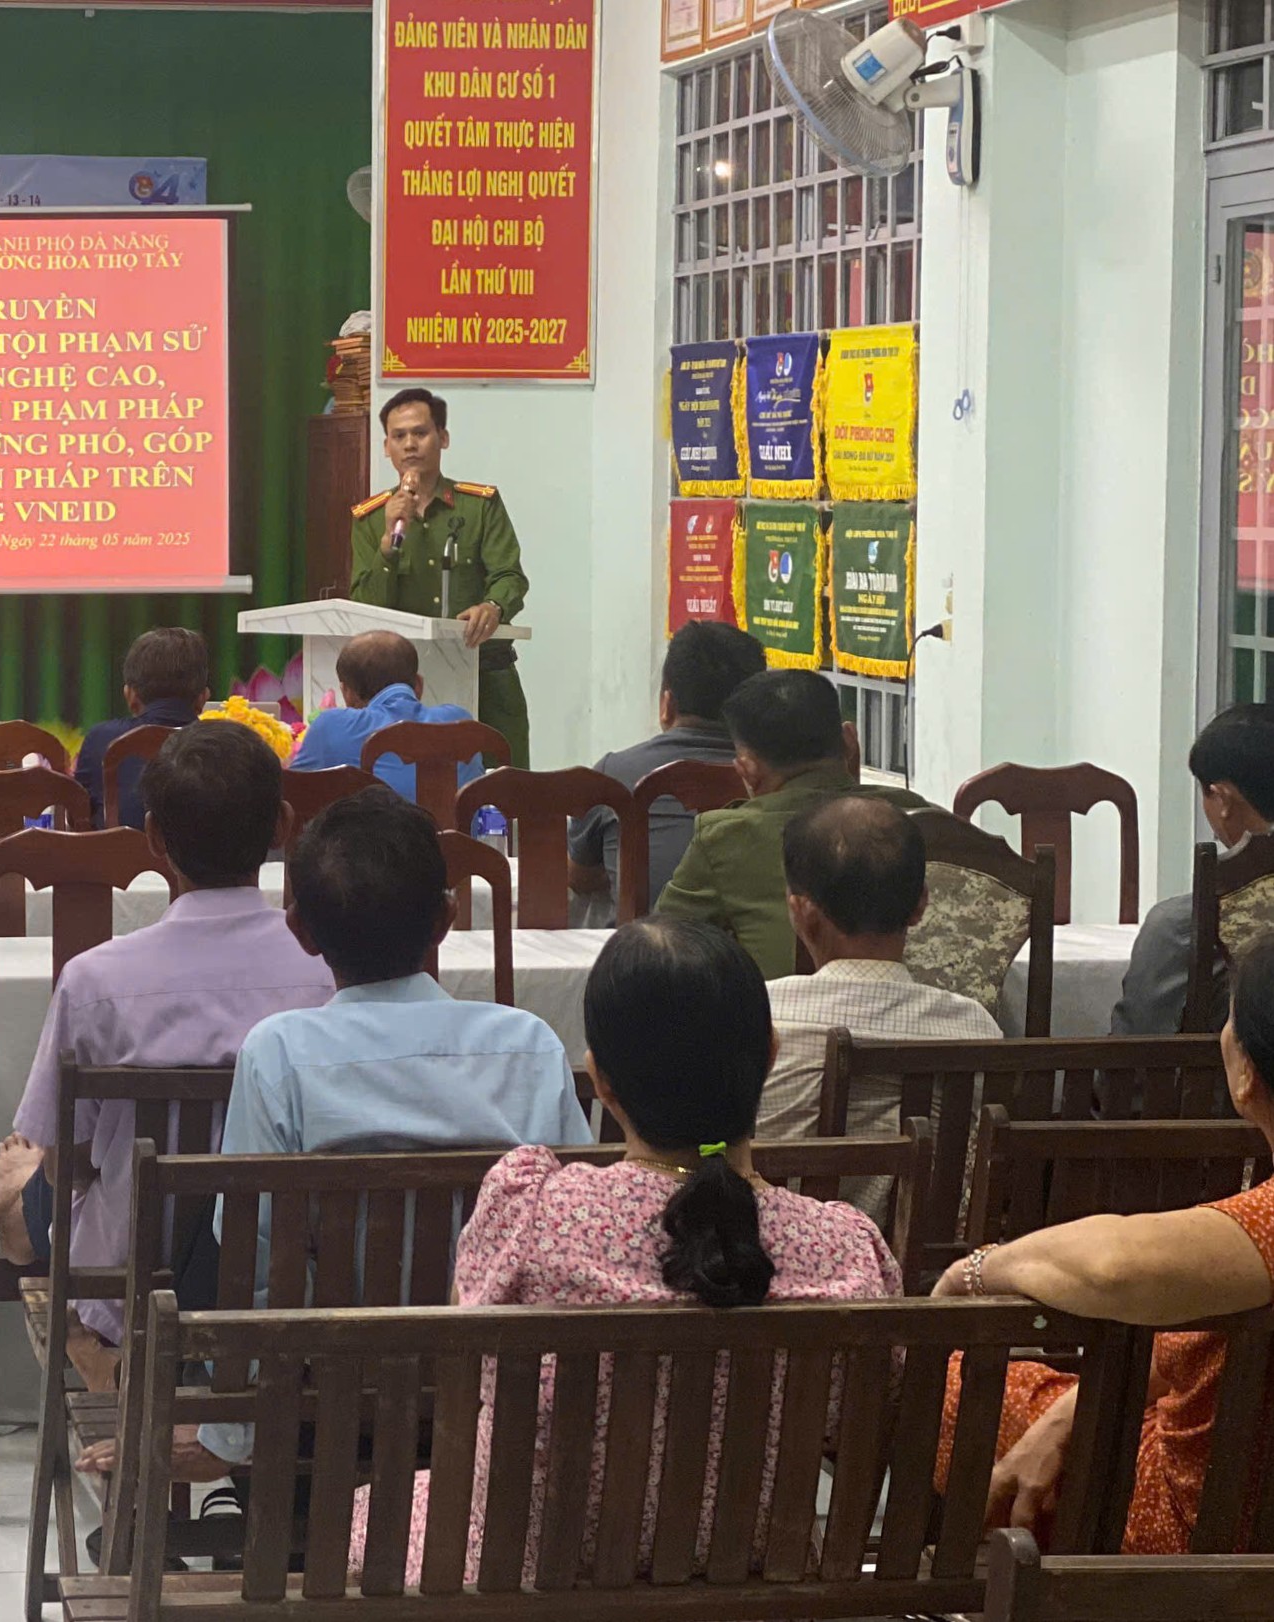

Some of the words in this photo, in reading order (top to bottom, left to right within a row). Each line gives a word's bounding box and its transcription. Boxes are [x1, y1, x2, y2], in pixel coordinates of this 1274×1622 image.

[394, 13, 437, 48] ĐẢNG
[442, 17, 478, 49] VIÊN
[483, 17, 502, 49] VÀ
[507, 18, 550, 49] NHÂN
[555, 18, 587, 50] DÂN
[424, 71, 456, 97] KHU
[460, 67, 492, 98] DÂN
[497, 70, 519, 98] CƯ
[523, 64, 544, 99] SỐ
[548, 74, 555, 98] 1
[404, 113, 453, 149] QUYẾT
[457, 116, 490, 148] TÂM
[495, 119, 534, 154] THỰC
[539, 117, 575, 154] HIỆN
[402, 160, 453, 196] THẮNG
[458, 168, 481, 202] LỢI
[486, 171, 524, 202] NGHỊ
[528, 163, 576, 199] QUYẾT
[8, 194, 19, 206] 13
[29, 195, 41, 206] 14
[36, 233, 75, 251] PHỐ
[80, 232, 107, 250] ĐÀ
[432, 219, 457, 251] ĐẠI
[463, 214, 488, 251] HỘI
[493, 220, 519, 246] CHI
[524, 215, 545, 251] BỘ
[47, 252, 91, 270] HÒA
[95, 253, 138, 272] THỌ
[144, 248, 183, 268] TÂY
[441, 259, 471, 294] LẦN
[476, 263, 507, 294] THỨ
[510, 269, 534, 295] VIII
[59, 332, 154, 358] PHẠM
[163, 324, 207, 352] SỬ
[407, 312, 457, 349] NHIỆM
[462, 312, 482, 344] KỲ
[486, 319, 568, 344] 2025-2027
[87, 364, 166, 389] CAO,
[13, 399, 109, 427] PHẠM
[118, 394, 204, 420] PHÁP
[59, 427, 135, 457] PHỐ,
[144, 426, 213, 454] GÓP
[14, 464, 100, 489] PHÁP
[107, 460, 195, 488] TRÊN
[14, 500, 117, 523] VNEID
[0, 534, 35, 550] Ngày
[39, 534, 57, 547] 22
[102, 533, 119, 546] 05
[123, 535, 153, 547] năm
[157, 532, 191, 546] 2025
